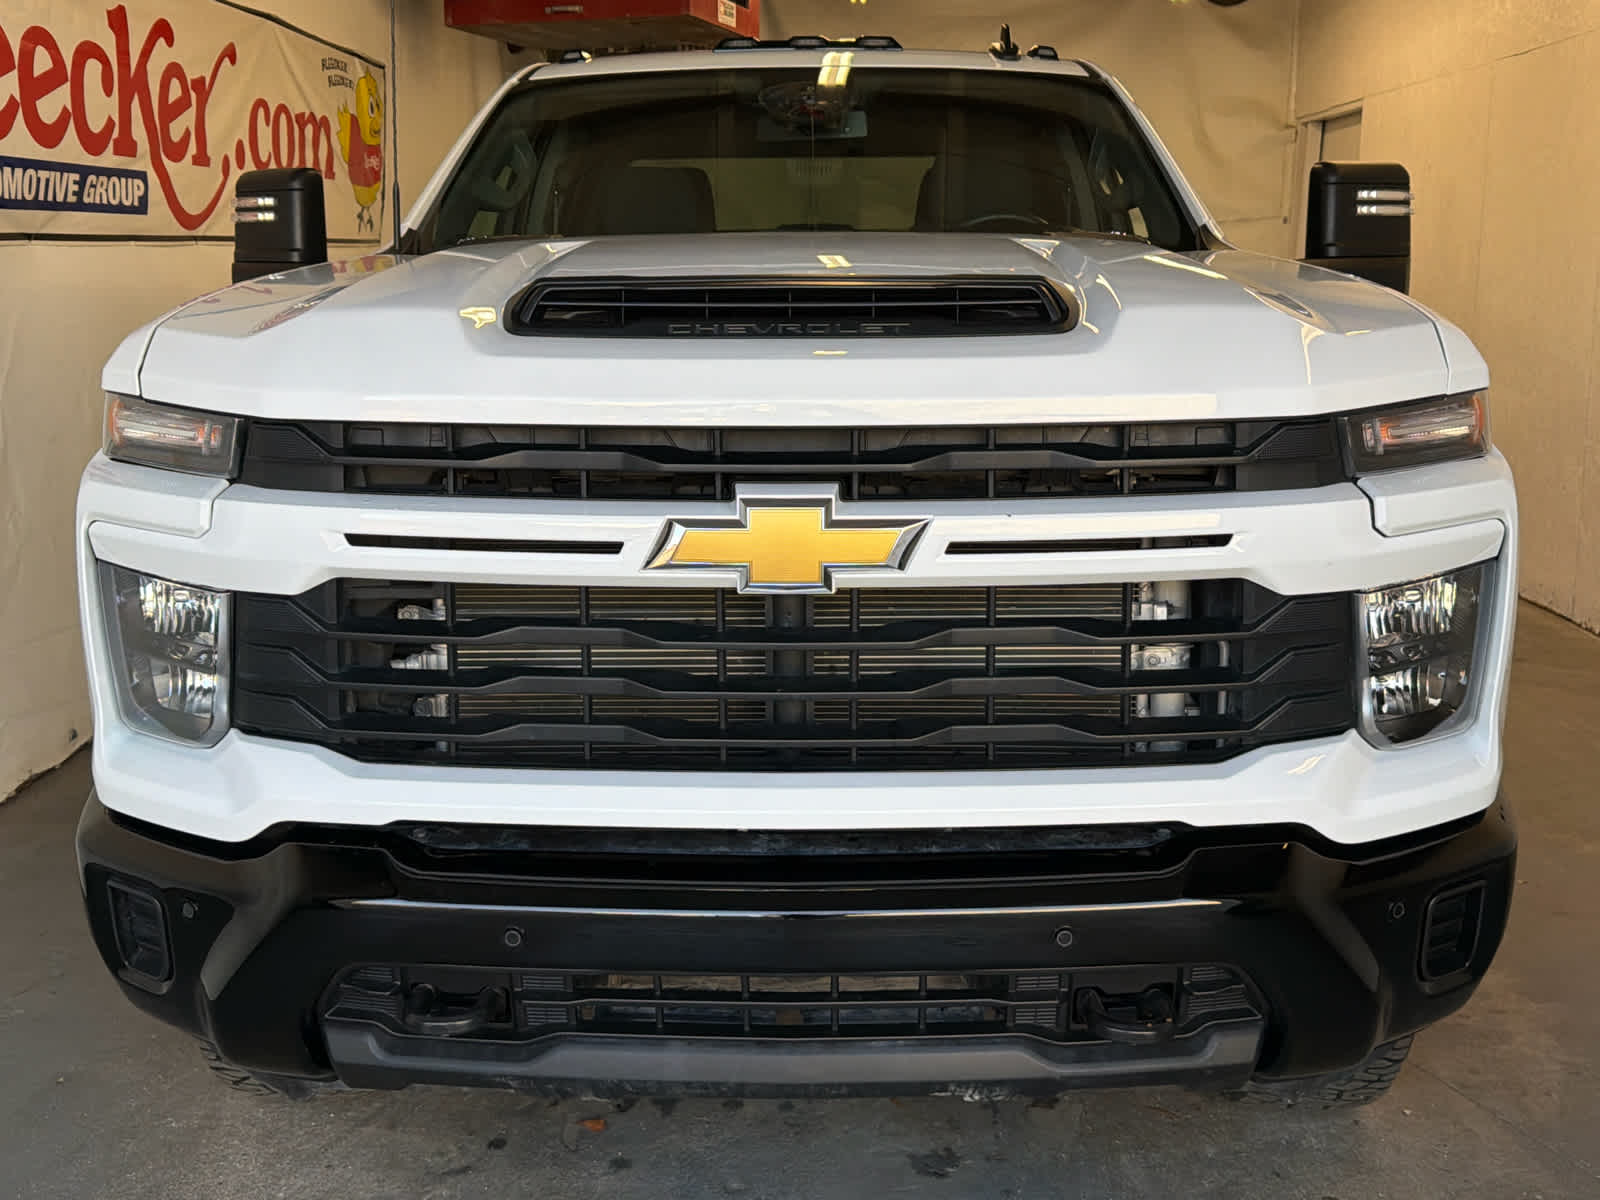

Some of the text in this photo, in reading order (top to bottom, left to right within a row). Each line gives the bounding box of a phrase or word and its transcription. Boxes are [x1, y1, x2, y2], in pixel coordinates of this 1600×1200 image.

[0, 166, 145, 207] MOTIVE GROUP
[667, 323, 911, 334] CHEVROLET
